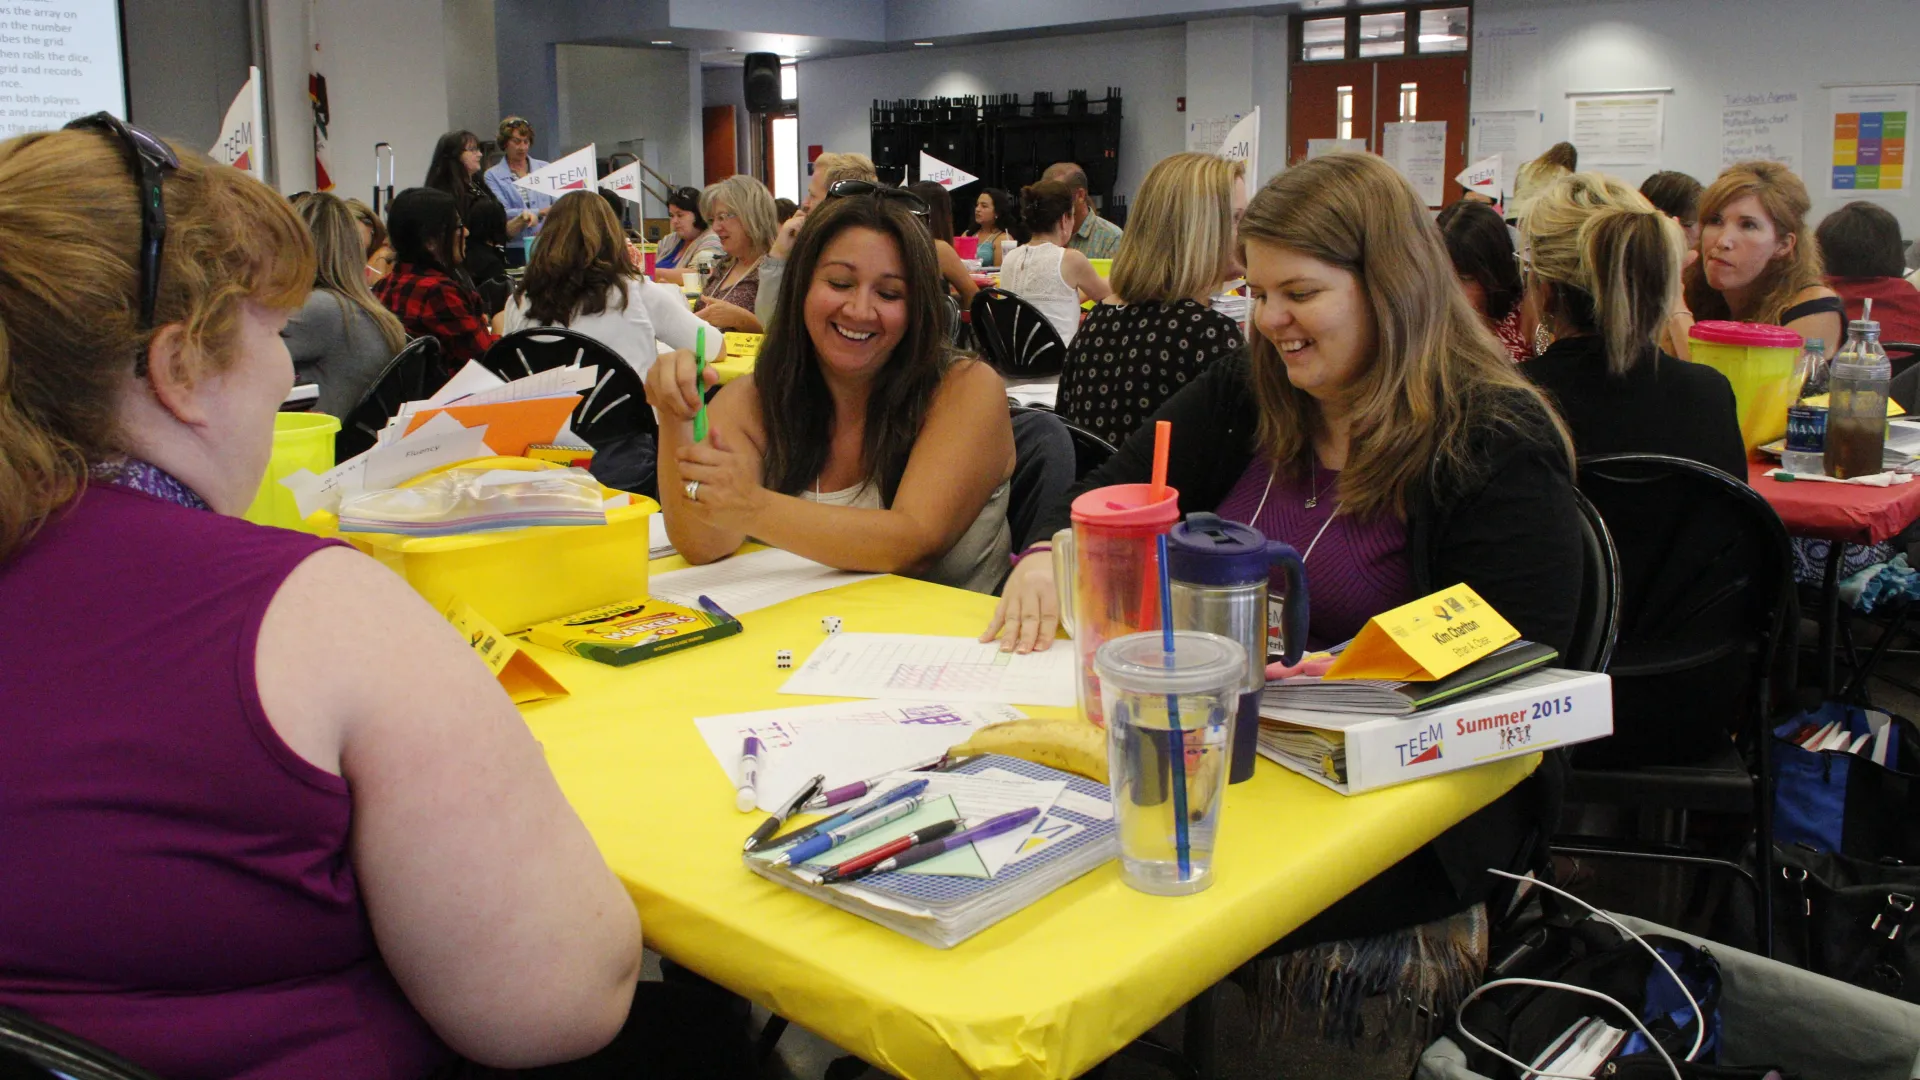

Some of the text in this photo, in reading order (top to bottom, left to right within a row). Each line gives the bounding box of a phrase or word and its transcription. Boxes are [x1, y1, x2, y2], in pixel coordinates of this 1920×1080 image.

[14, 6, 31, 16] the
[34, 9, 60, 19] array
[11, 20, 28, 30] the
[31, 23, 72, 33] number
[23, 36, 41, 45] the
[23, 51, 45, 60] rolls
[48, 52, 65, 61] the
[21, 65, 41, 74] and
[44, 67, 83, 77] records
[15, 93, 41, 103] both
[43, 95, 80, 106] players
[9, 108, 28, 117] and
[31, 109, 67, 118] cannot
[224, 121, 252, 165] TEEM
[529, 176, 541, 185] 18
[548, 166, 588, 190] TEEM
[610, 174, 634, 190] TEEM
[928, 168, 955, 181] TEEM
[1468, 168, 1495, 185] TEEM
[567, 605, 634, 623] Crayola
[601, 616, 698, 640] MARKERS
[1432, 620, 1480, 645] Kim Charlton
[1456, 696, 1573, 736] Summer 2015
[1395, 722, 1444, 767] TEEM
